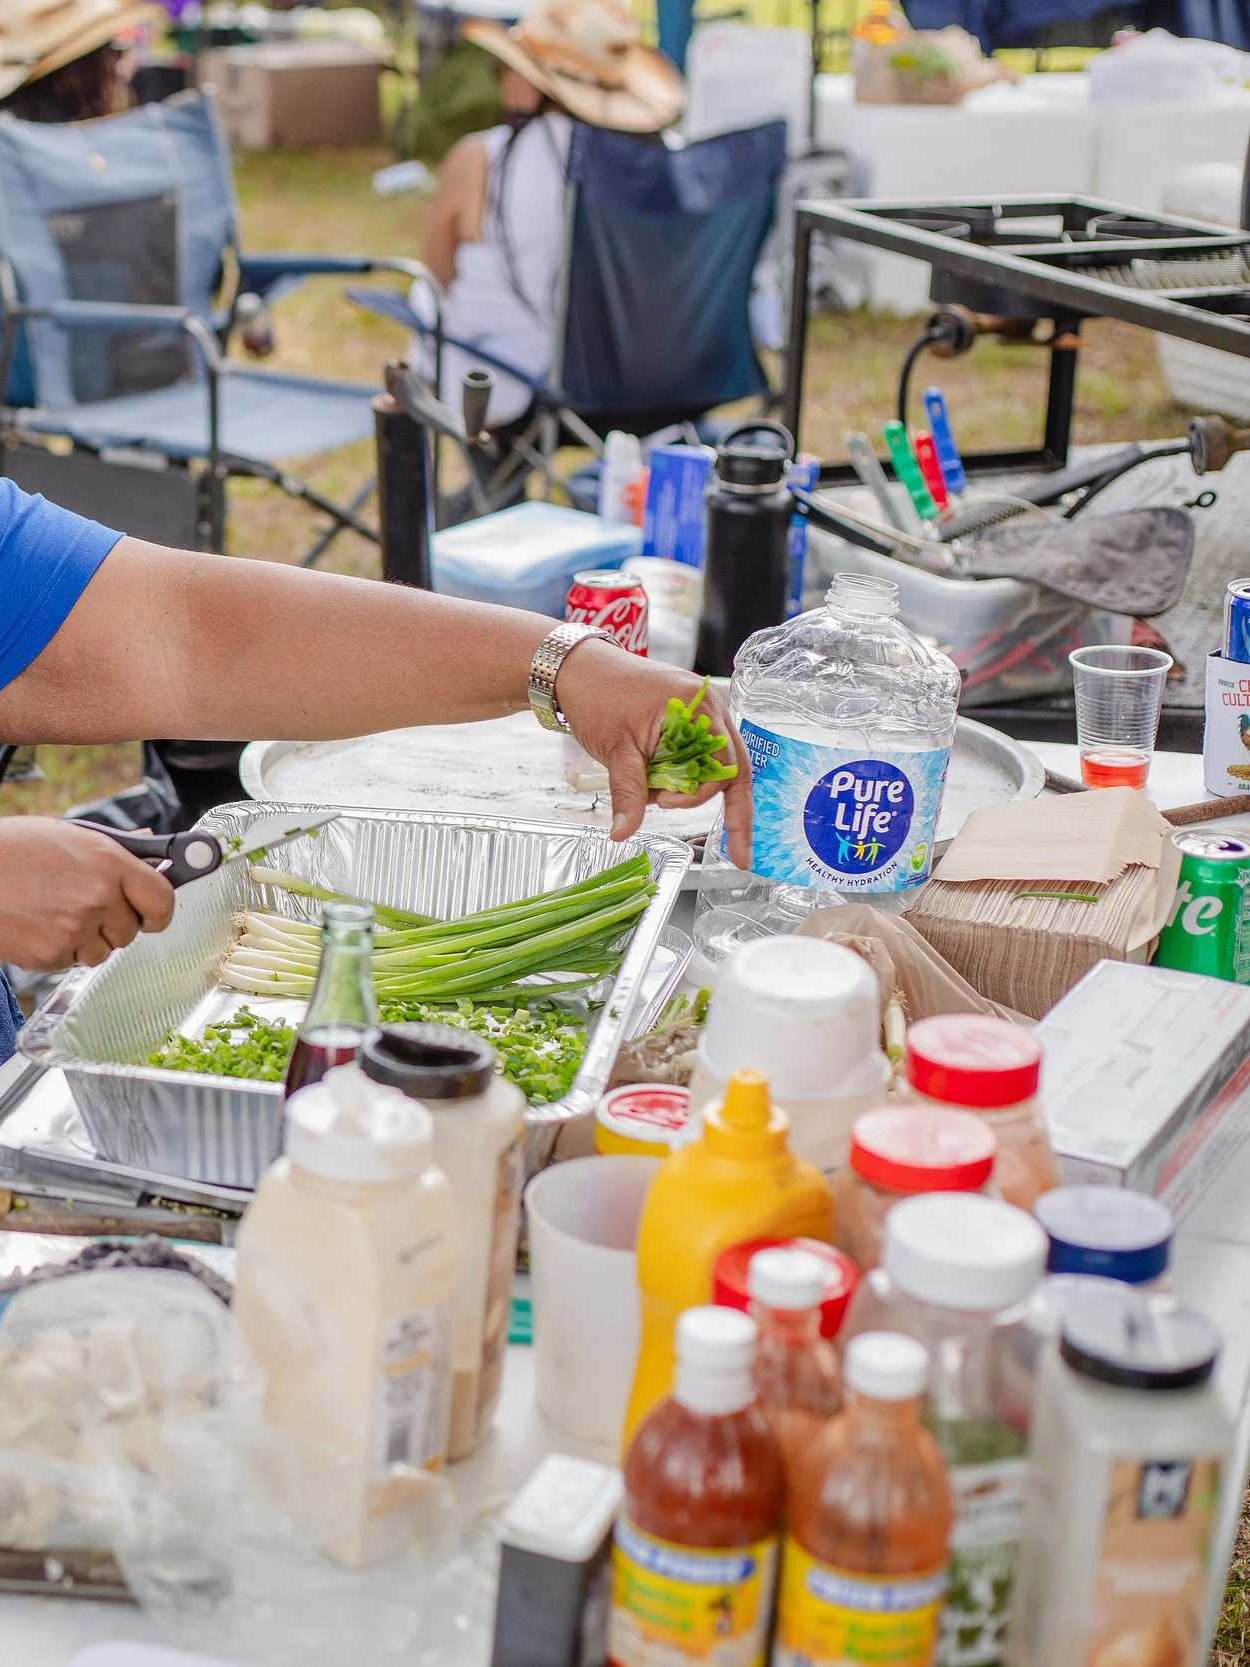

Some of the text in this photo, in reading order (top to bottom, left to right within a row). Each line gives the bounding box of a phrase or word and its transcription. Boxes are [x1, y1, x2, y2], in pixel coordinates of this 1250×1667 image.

[742, 728, 780, 757] PURIFIED
[747, 748, 768, 769] TER
[830, 771, 905, 803] Pure
[835, 802, 897, 840] Life
[806, 857, 845, 885] HEALTHY
[847, 861, 898, 887] HYDRATION
[1166, 880, 1224, 936] te
